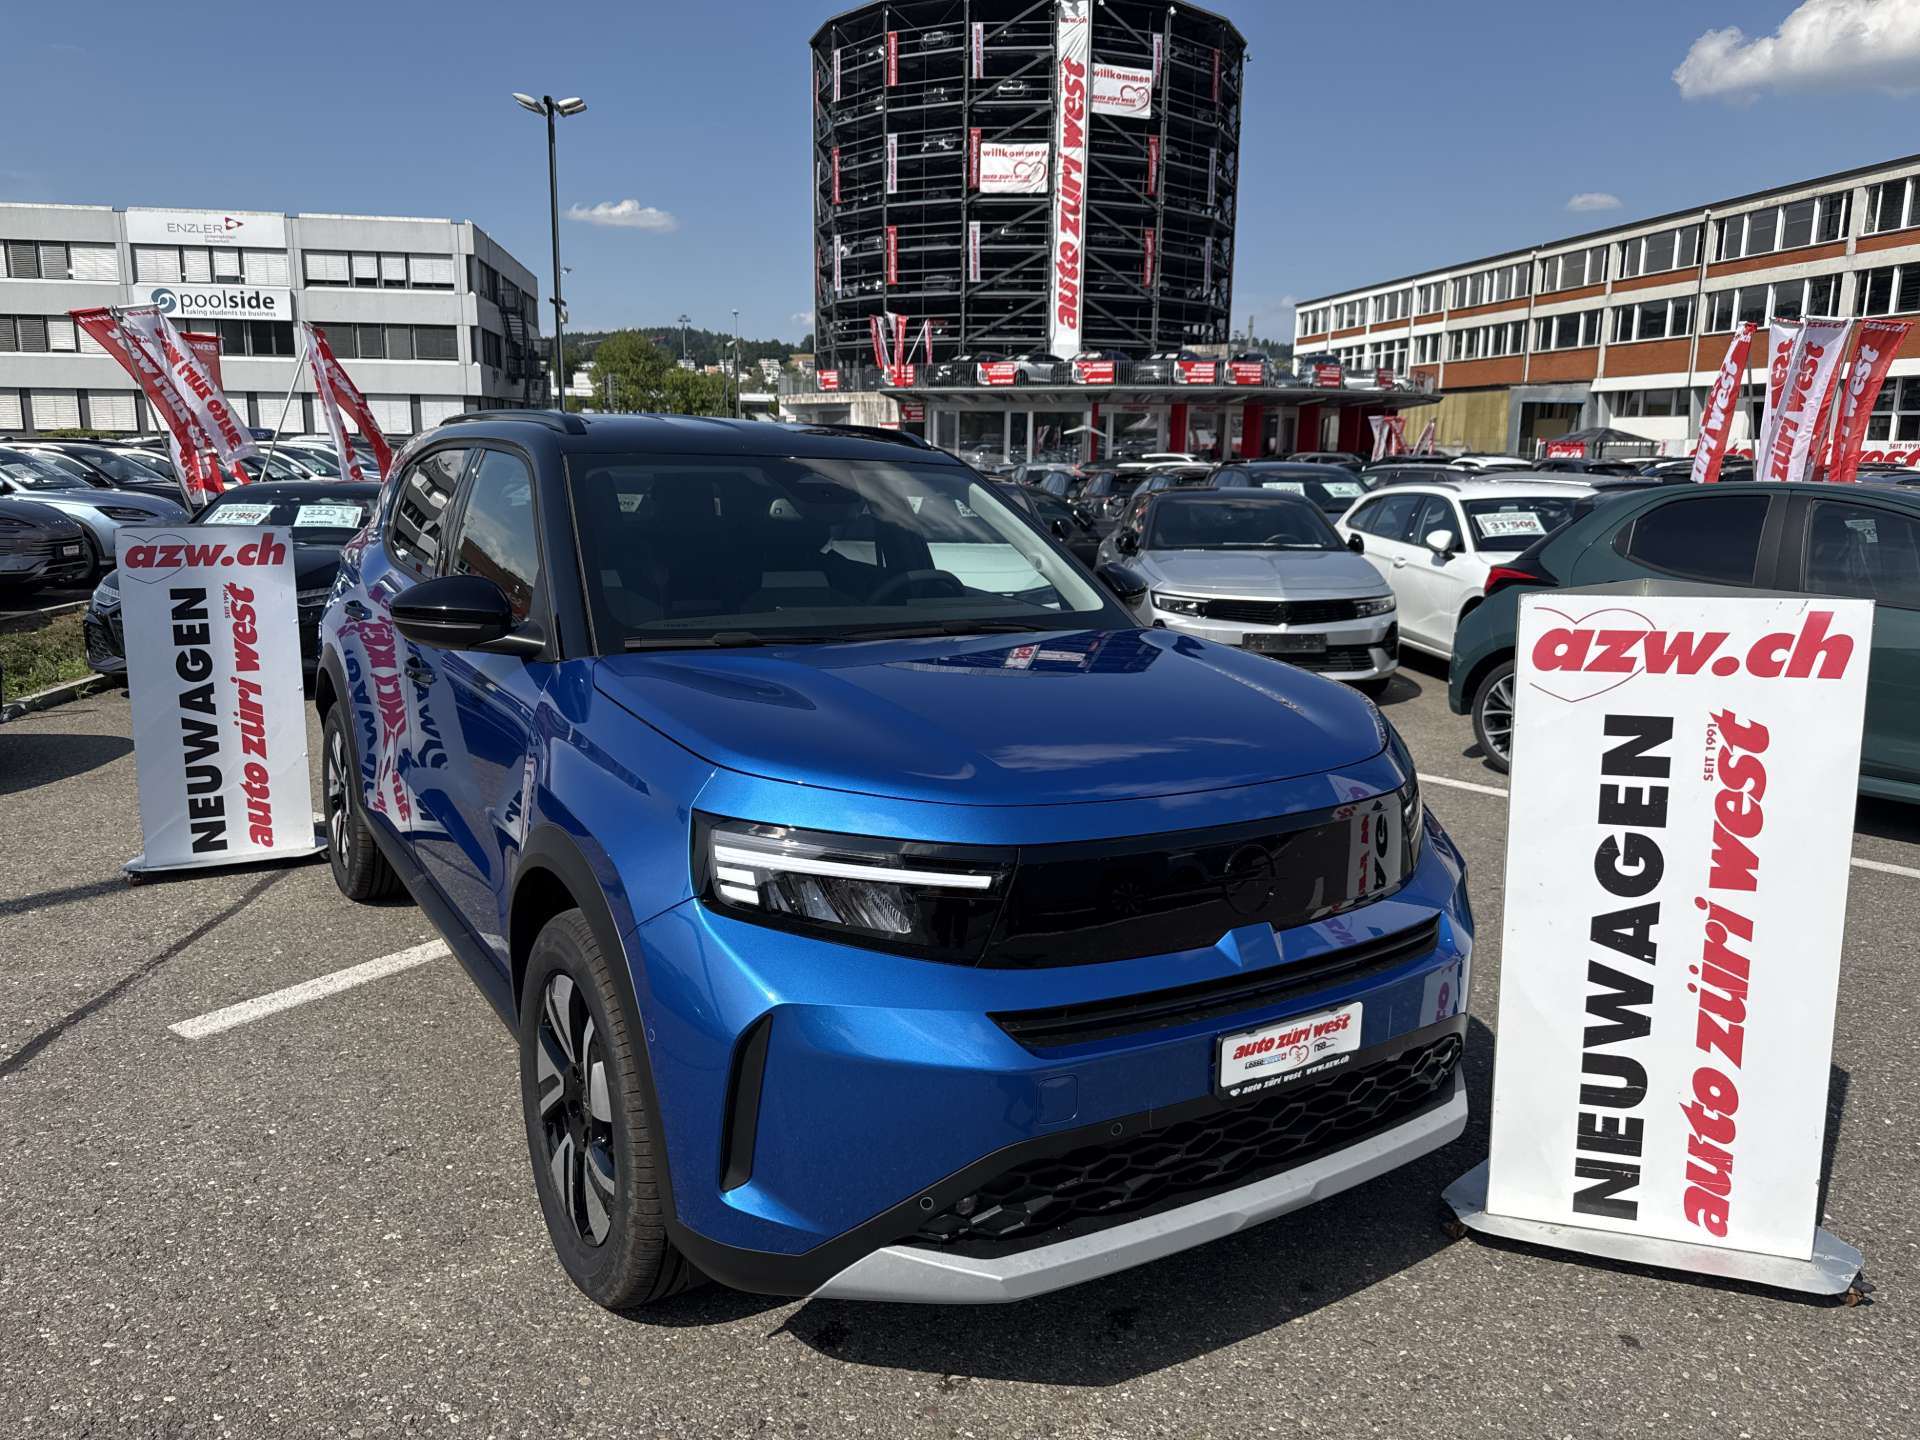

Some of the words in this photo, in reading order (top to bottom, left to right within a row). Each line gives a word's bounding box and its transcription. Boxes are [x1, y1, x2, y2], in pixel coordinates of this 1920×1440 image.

[1060, 57, 1086, 149] west
[1091, 68, 1150, 83] willkommen
[982, 147, 1047, 158] willkommen
[167, 223, 223, 233] ENZLER
[1056, 152, 1083, 238] züri
[180, 289, 275, 314] poolside
[186, 308, 208, 317] taking
[209, 309, 238, 317] students
[1056, 242, 1079, 329] auto
[1771, 416, 1799, 482] züri
[1785, 340, 1824, 413] west
[125, 532, 287, 568] azw.ch
[225, 583, 261, 672] west
[1531, 611, 1855, 680] azw.ch
[169, 587, 229, 854] NEUWAGEN
[232, 676, 268, 760] züri
[1706, 723, 1717, 751] 1991
[241, 763, 274, 849] auto
[1703, 756, 1714, 782] SEIT
[1708, 709, 1771, 893] west
[1573, 714, 1675, 1222] NEUWAGEN
[1688, 896, 1754, 1071] züri
[1233, 1036, 1276, 1060] auto
[1275, 1023, 1313, 1050] züri
[1313, 1012, 1352, 1038] west
[1242, 1083, 1262, 1095] auto
[1263, 1077, 1282, 1089] züri
[1283, 1070, 1303, 1082] west
[1680, 1066, 1739, 1238] auto
